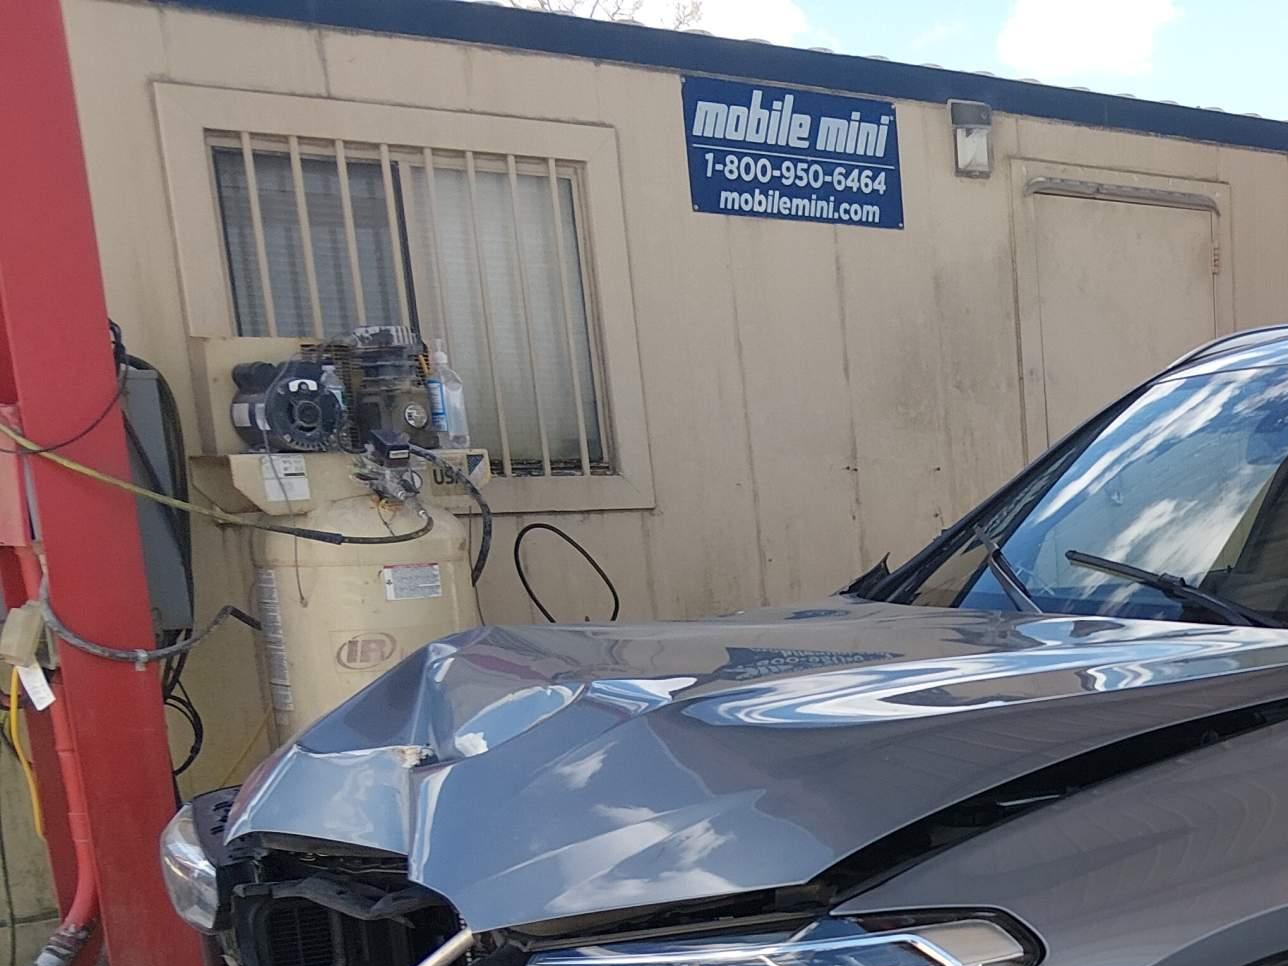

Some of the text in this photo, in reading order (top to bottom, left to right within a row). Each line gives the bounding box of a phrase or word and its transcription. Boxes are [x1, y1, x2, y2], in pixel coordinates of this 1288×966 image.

[692, 90, 890, 157] mobile mini
[704, 152, 886, 195] 1-800-950-6464
[719, 189, 880, 223] mobilemini.com
